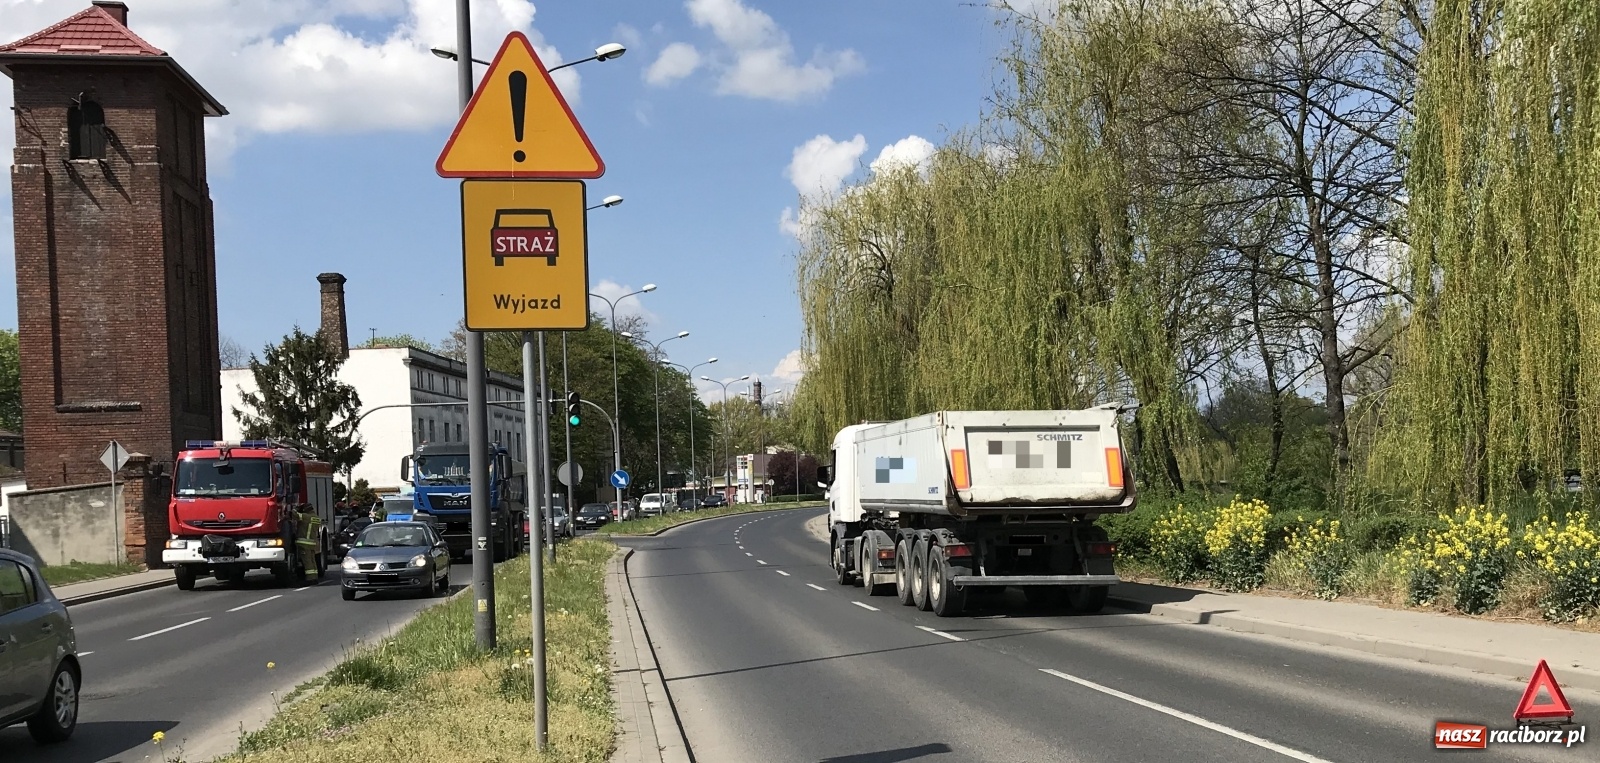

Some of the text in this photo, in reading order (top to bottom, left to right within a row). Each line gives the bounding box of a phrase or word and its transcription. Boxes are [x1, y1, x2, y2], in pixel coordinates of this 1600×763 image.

[496, 231, 555, 252] STRAŻ
[493, 294, 561, 314] Wyjazd
[1036, 433, 1083, 441] SCHMITZ
